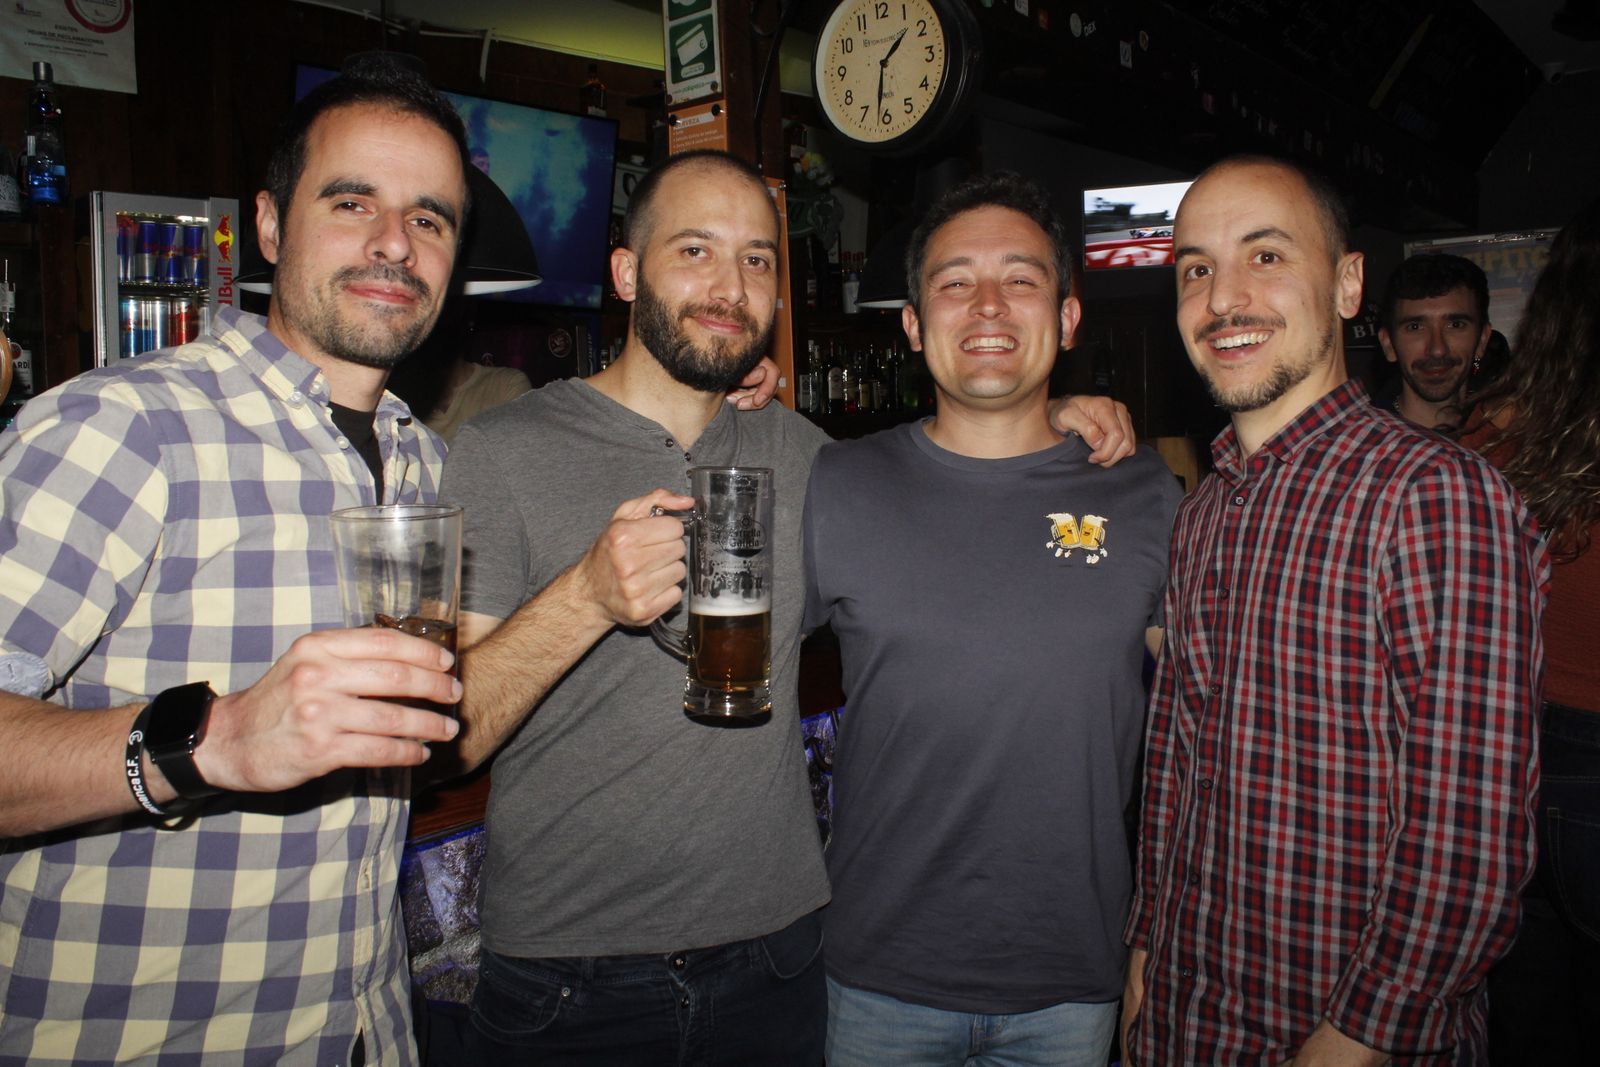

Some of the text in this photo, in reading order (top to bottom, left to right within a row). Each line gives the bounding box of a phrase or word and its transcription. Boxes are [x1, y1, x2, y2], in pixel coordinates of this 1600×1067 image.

[875, 2, 889, 20] 12
[902, 4, 907, 21] 1
[857, 13, 867, 31] 11
[916, 19, 927, 37] 2
[841, 37, 853, 54] 10
[924, 45, 935, 63] 3
[837, 66, 847, 81] 9
[919, 74, 929, 91] 4
[844, 90, 853, 106] 8
[903, 97, 914, 114] 5
[860, 105, 869, 122] 7
[881, 108, 892, 125] 6
[217, 267, 232, 296] Bull
